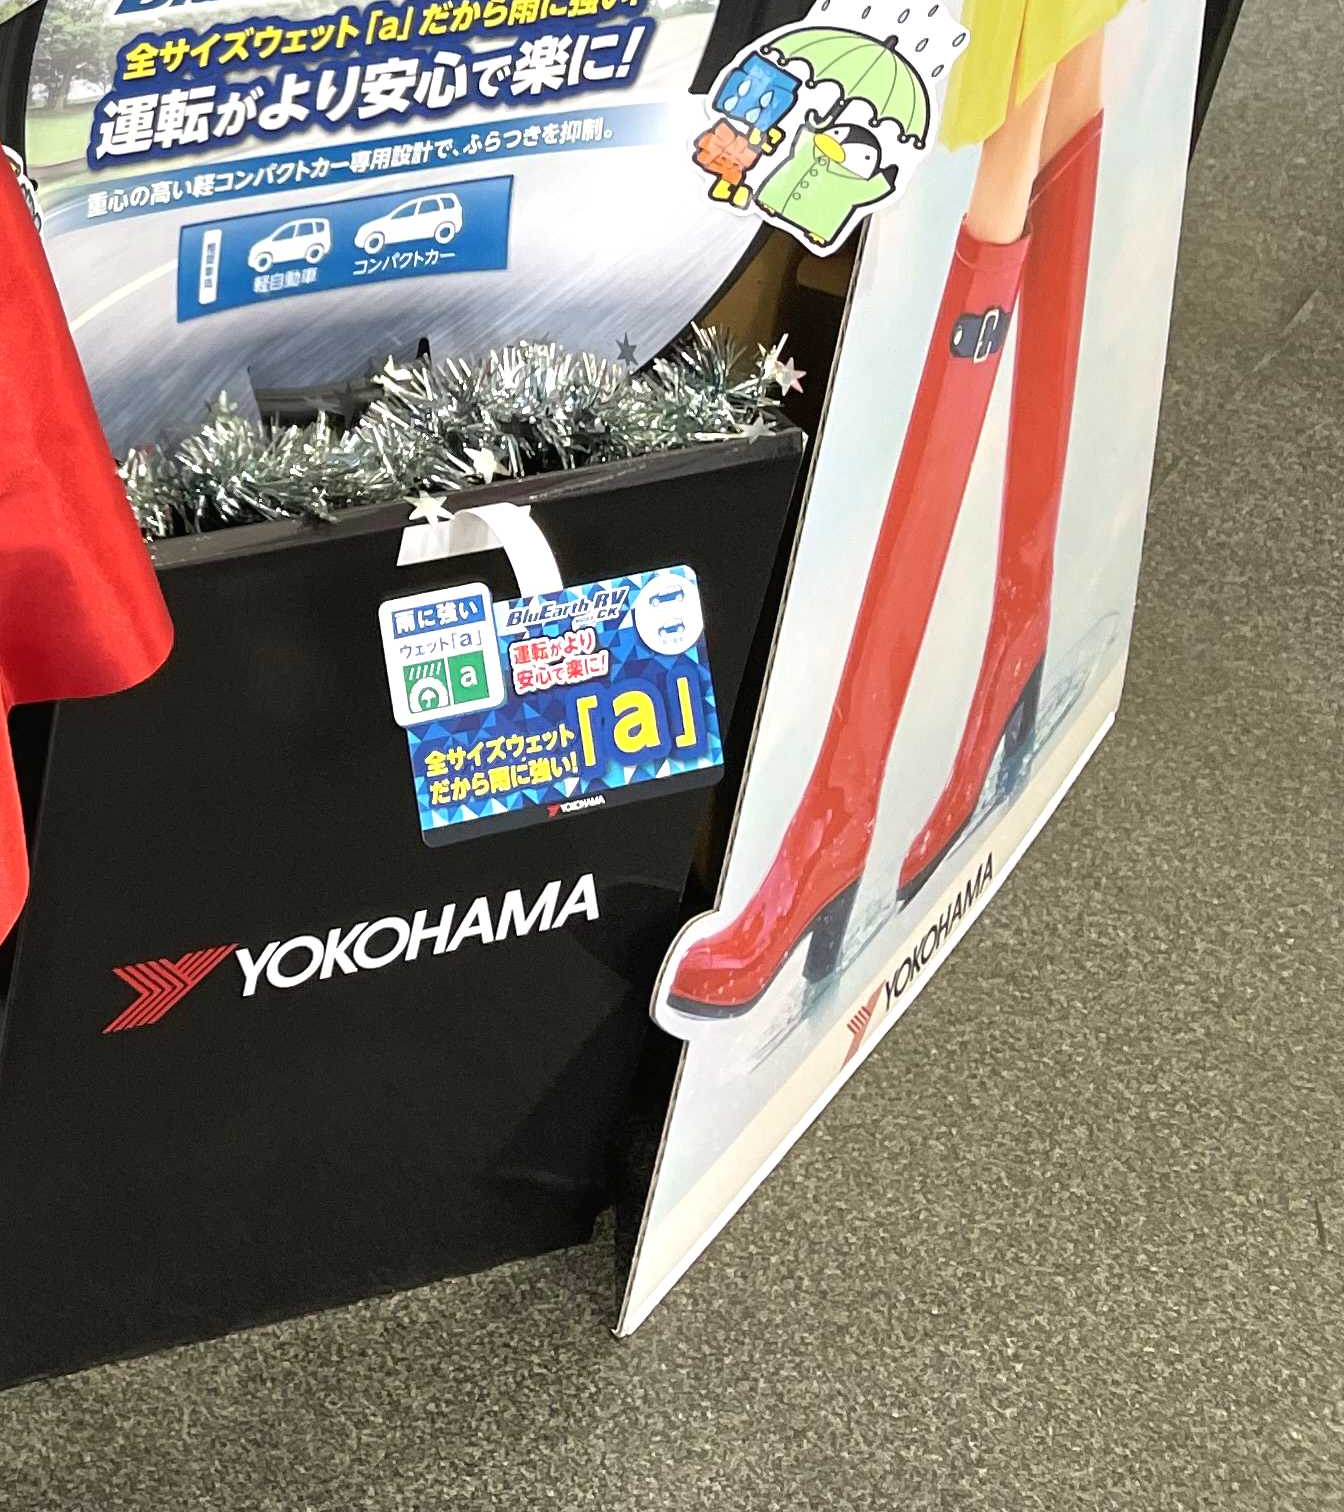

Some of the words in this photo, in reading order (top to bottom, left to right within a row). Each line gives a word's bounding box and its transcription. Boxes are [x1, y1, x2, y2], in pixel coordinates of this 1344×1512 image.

[95, 27, 636, 160] 運転がより安心で楽に!
[353, 250, 456, 276] コンパクトカー
[393, 596, 483, 637] 雨に強い
[459, 666, 479, 689] a
[424, 723, 576, 778] 全サイズウェット
[234, 873, 600, 997] YOKOHAMA
[885, 852, 993, 1012] YOKOHAMA
